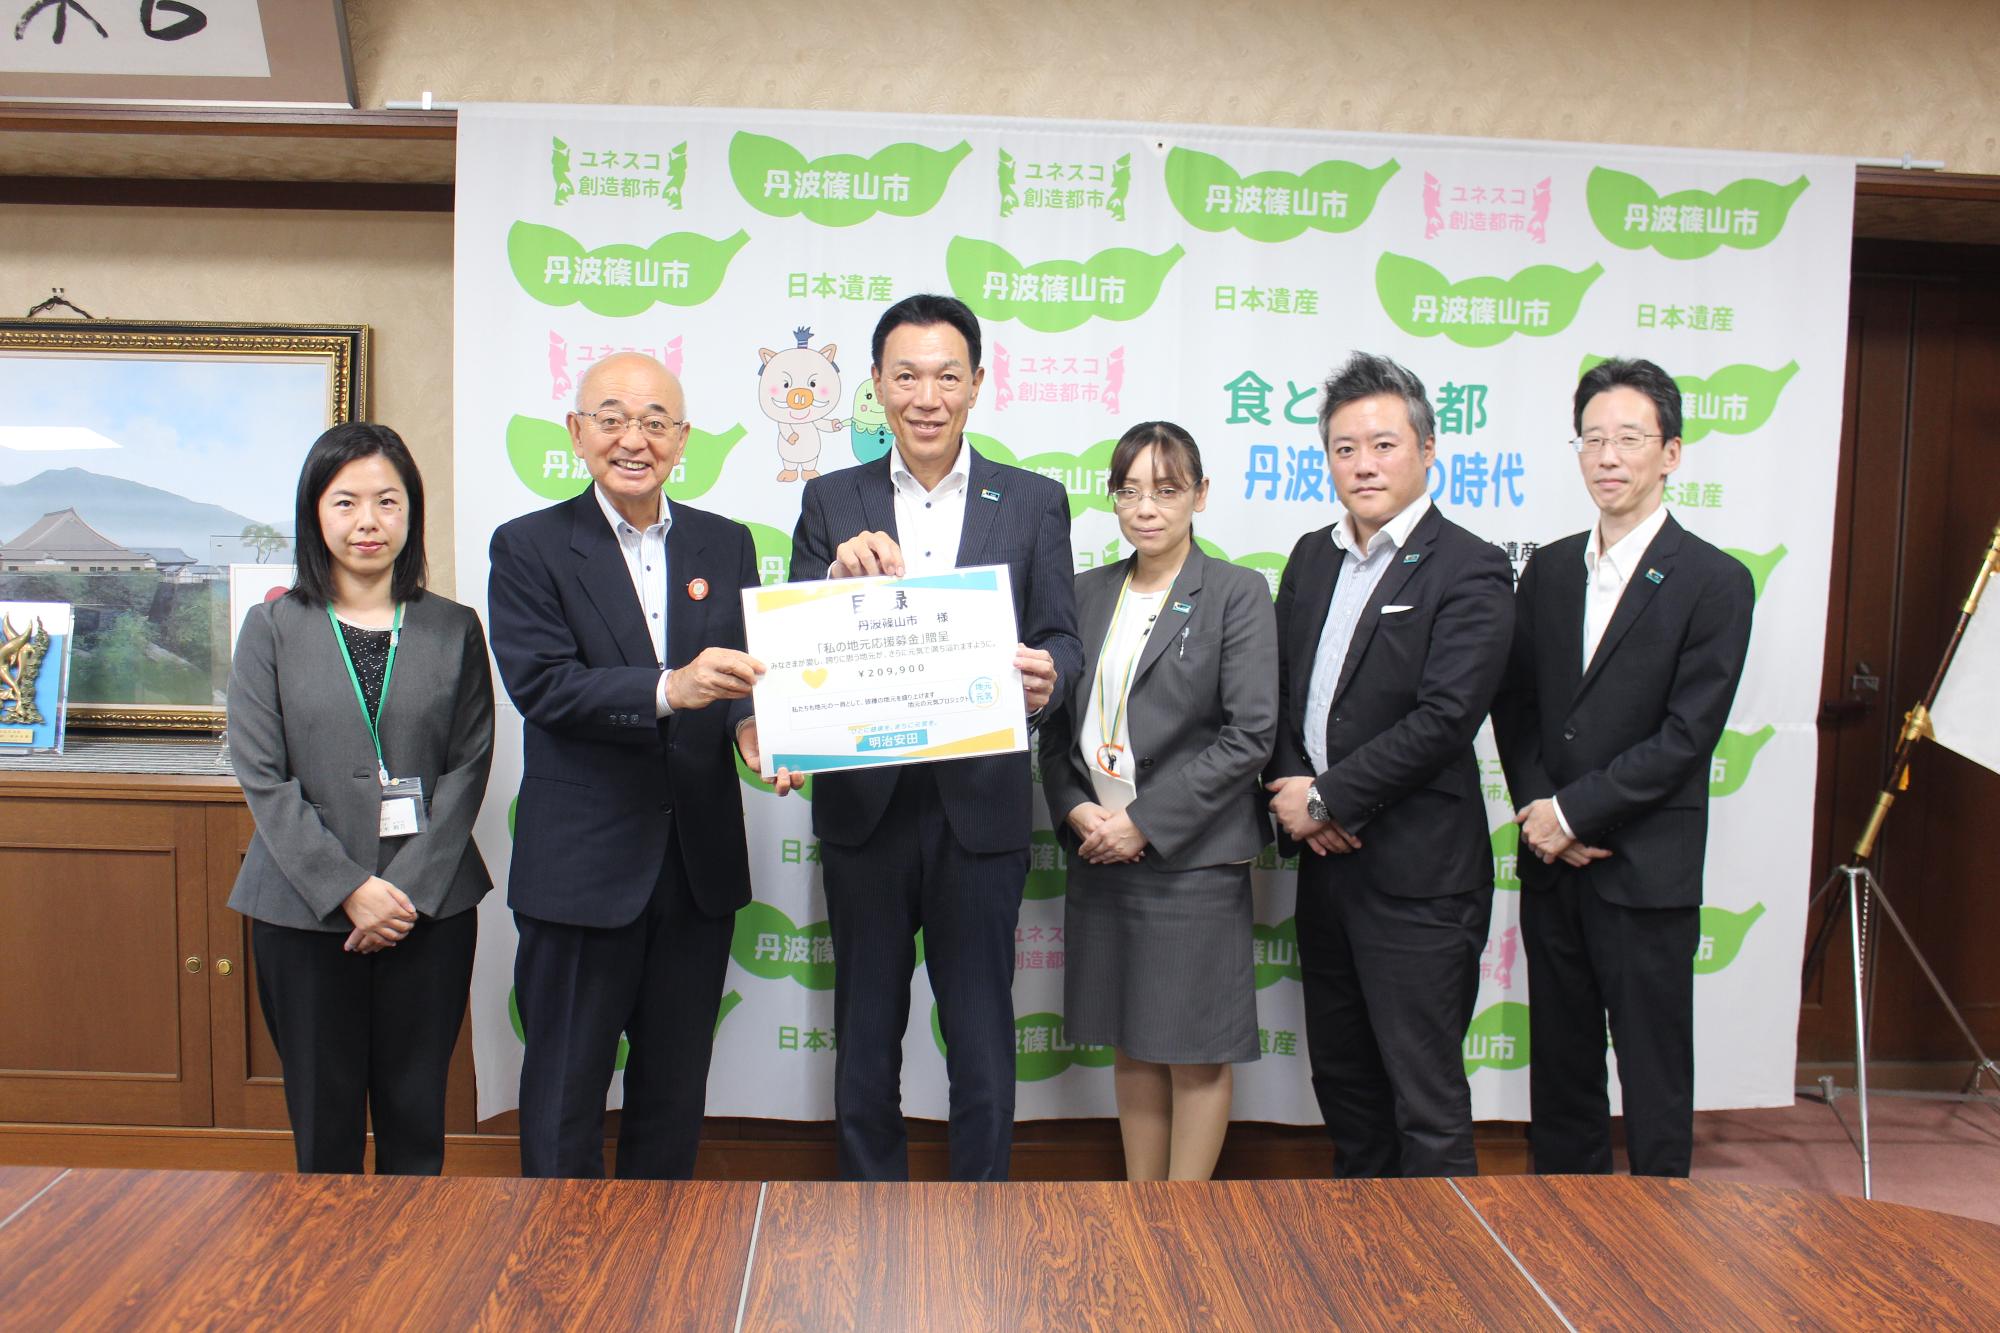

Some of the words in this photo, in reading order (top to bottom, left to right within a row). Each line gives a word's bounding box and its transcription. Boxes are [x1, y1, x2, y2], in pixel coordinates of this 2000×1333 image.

[579, 150, 661, 171] ユネスコ
[1025, 162, 1104, 182] ユネスコ
[578, 175, 660, 198] 創造都市
[763, 169, 911, 203] 丹波篠山市
[1023, 188, 1104, 210] 創造都市
[1450, 186, 1526, 206] ユネスコ
[1204, 183, 1348, 219] 丹波篠山市
[1448, 211, 1525, 233] 創造都市
[1623, 202, 1759, 236] 丹波篠山市
[543, 255, 690, 289] 丹波篠山市
[788, 272, 892, 302] 日本遺産
[982, 271, 1127, 305] 丹波篠山市
[1214, 285, 1318, 316] 日本遺産
[1411, 295, 1551, 327] 丹波篠山市
[1637, 303, 1734, 332] 日本遺産
[1019, 356, 1099, 376] ユネスコ
[1018, 381, 1098, 404] 創造都市
[1223, 370, 1488, 435] 食と都
[858, 615, 918, 631] 丹波篠山市
[936, 612, 949, 623] 様
[869, 732, 918, 748] 明治安田
